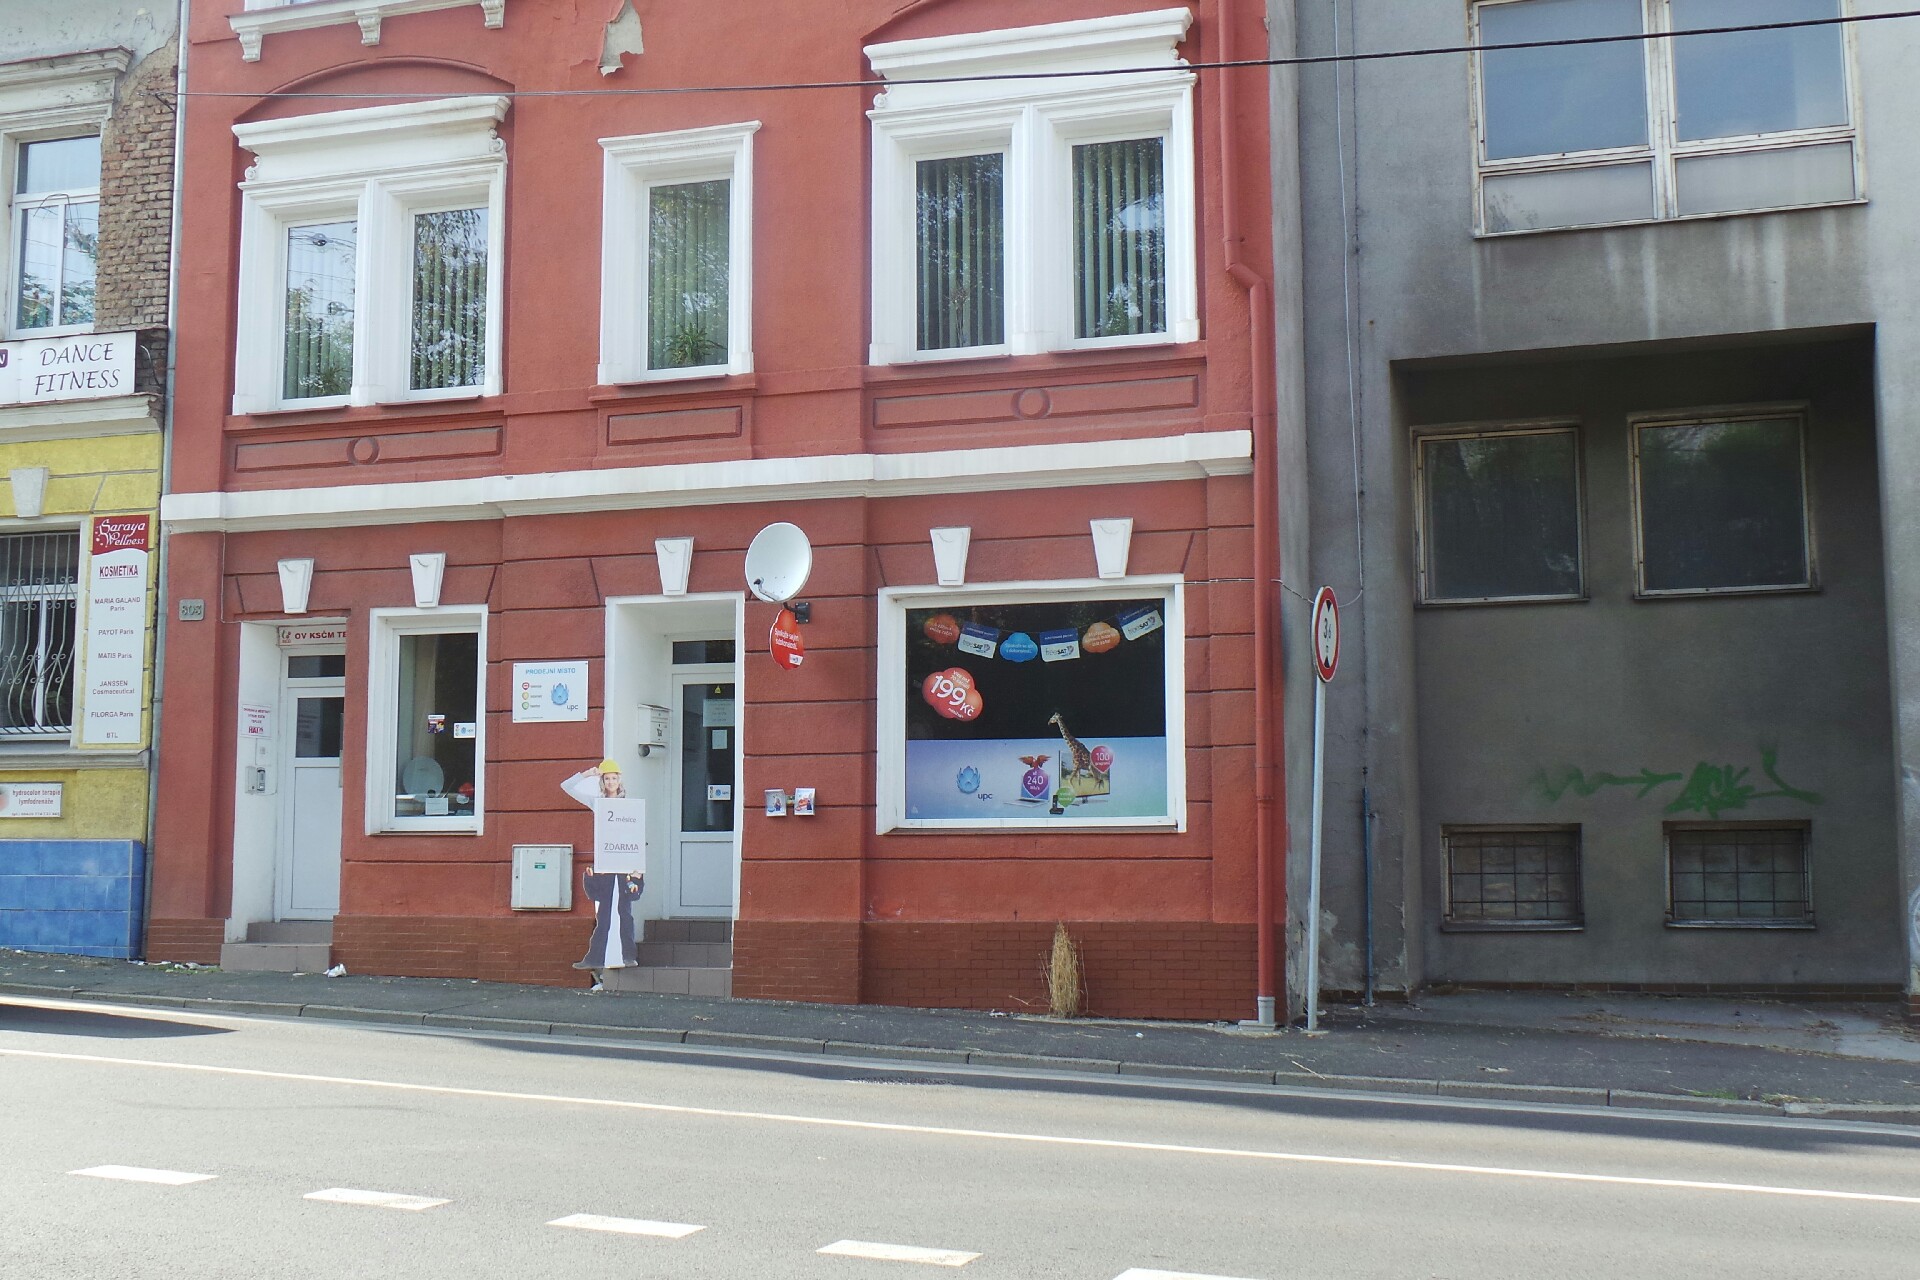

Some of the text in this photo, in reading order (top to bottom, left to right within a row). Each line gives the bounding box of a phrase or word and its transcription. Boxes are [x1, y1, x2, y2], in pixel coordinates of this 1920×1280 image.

[40, 343, 113, 366] DANCE
[35, 369, 120, 395] FITNESS
[99, 519, 146, 538] Saraya
[107, 532, 145, 546] Wellness
[100, 565, 138, 577] KOSMETIKA
[309, 630, 335, 638] KSČM
[931, 675, 966, 705] 199
[567, 704, 578, 712] upc
[960, 702, 975, 716] Kč
[1096, 752, 1110, 761] 100
[1027, 775, 1044, 785] 240
[977, 793, 992, 801] upc
[607, 811, 614, 822] 2
[604, 842, 639, 851] ZDARMA
